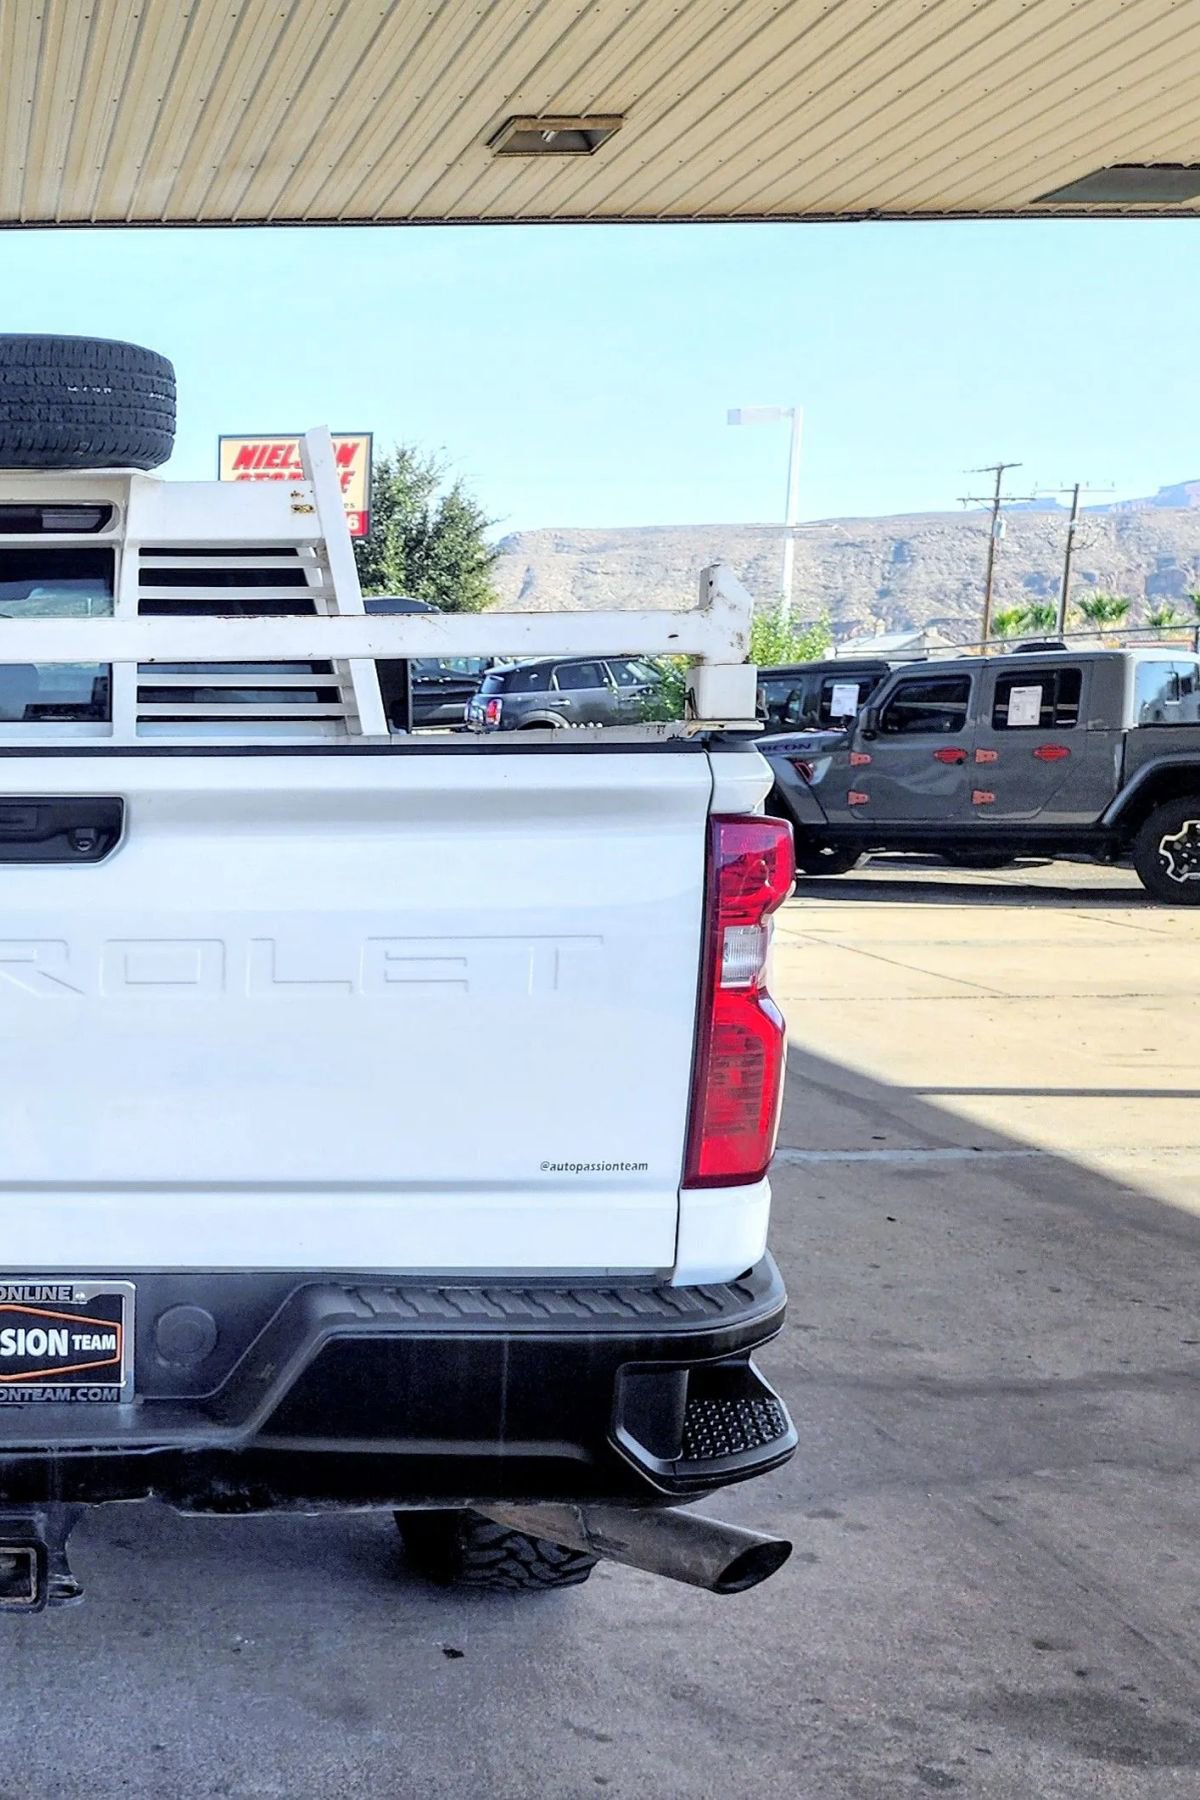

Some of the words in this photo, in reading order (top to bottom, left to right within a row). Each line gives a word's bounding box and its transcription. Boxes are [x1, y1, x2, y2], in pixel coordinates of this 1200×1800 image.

[232, 442, 360, 470] NIELN
[539, 1161, 649, 1174] @autopassionteam
[71, 1333, 117, 1350] TEAM
